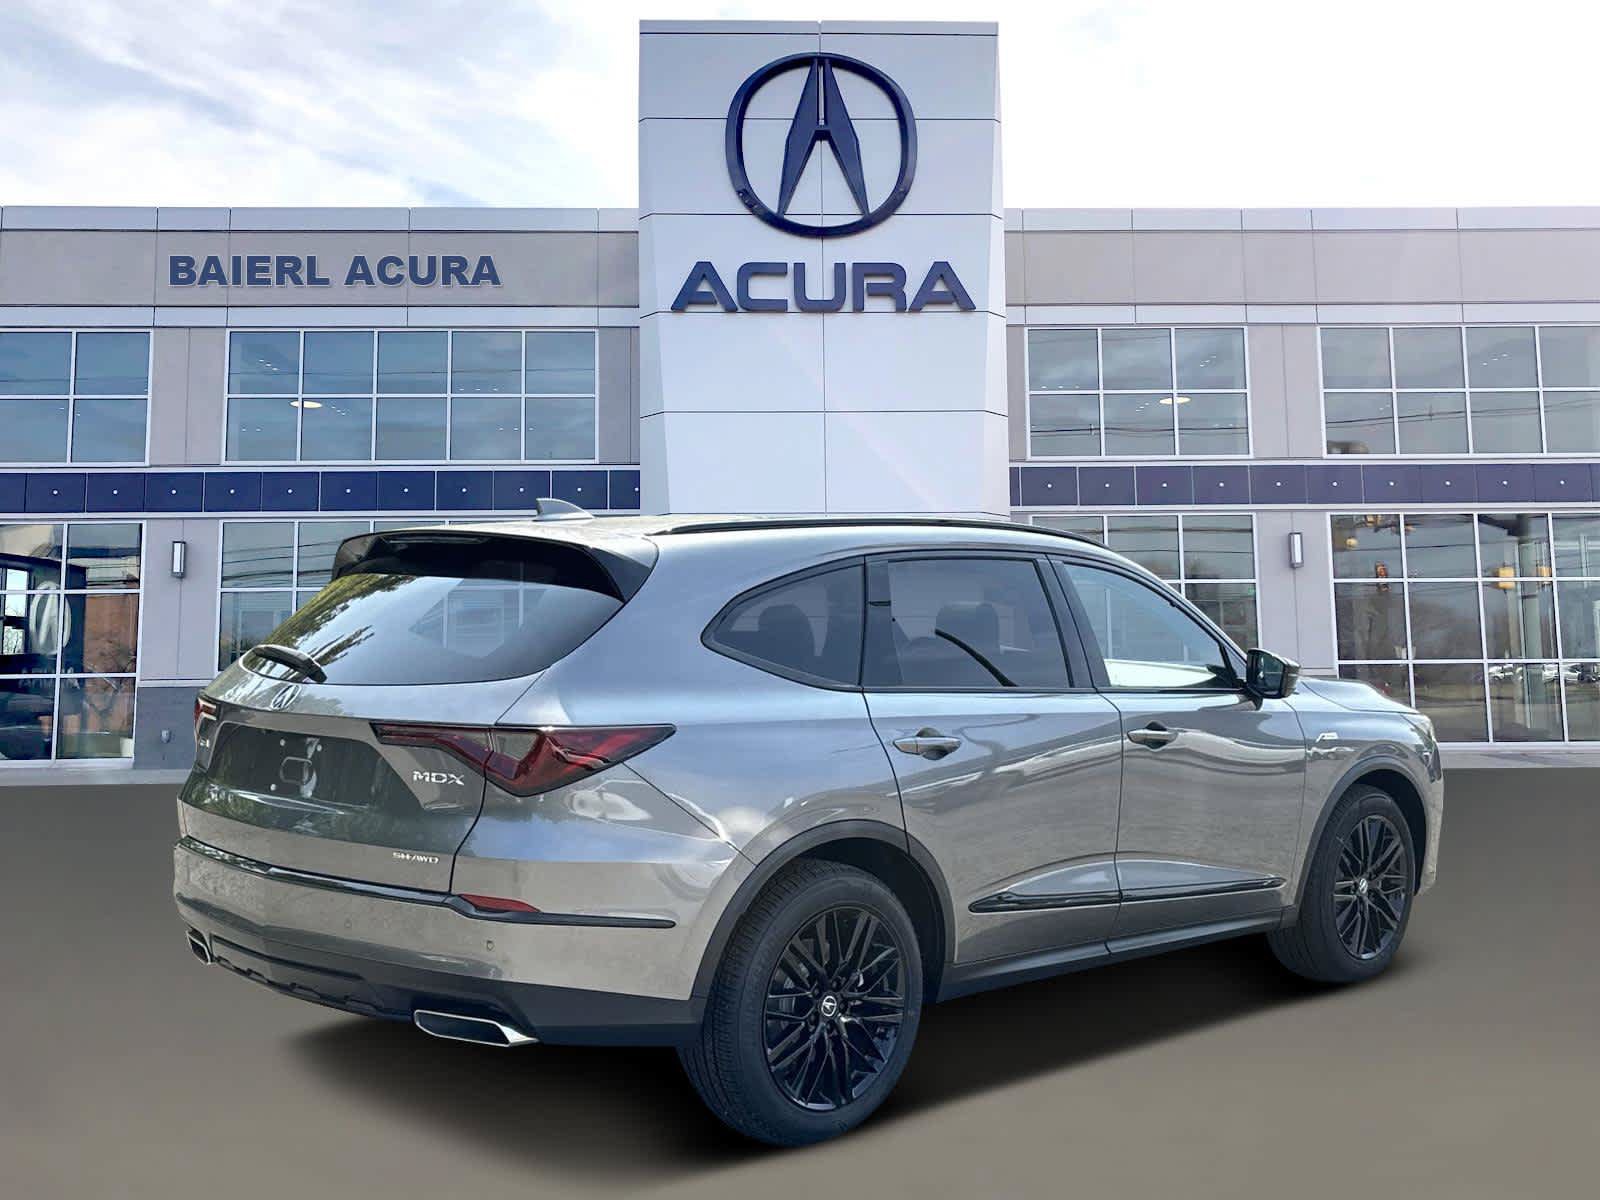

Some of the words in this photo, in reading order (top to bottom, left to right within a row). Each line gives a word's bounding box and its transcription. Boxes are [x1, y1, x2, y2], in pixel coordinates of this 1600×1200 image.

[169, 255, 331, 287] BAIERL
[344, 255, 502, 287] ACURA
[671, 261, 976, 312] ACURA
[413, 771, 465, 786] MDX
